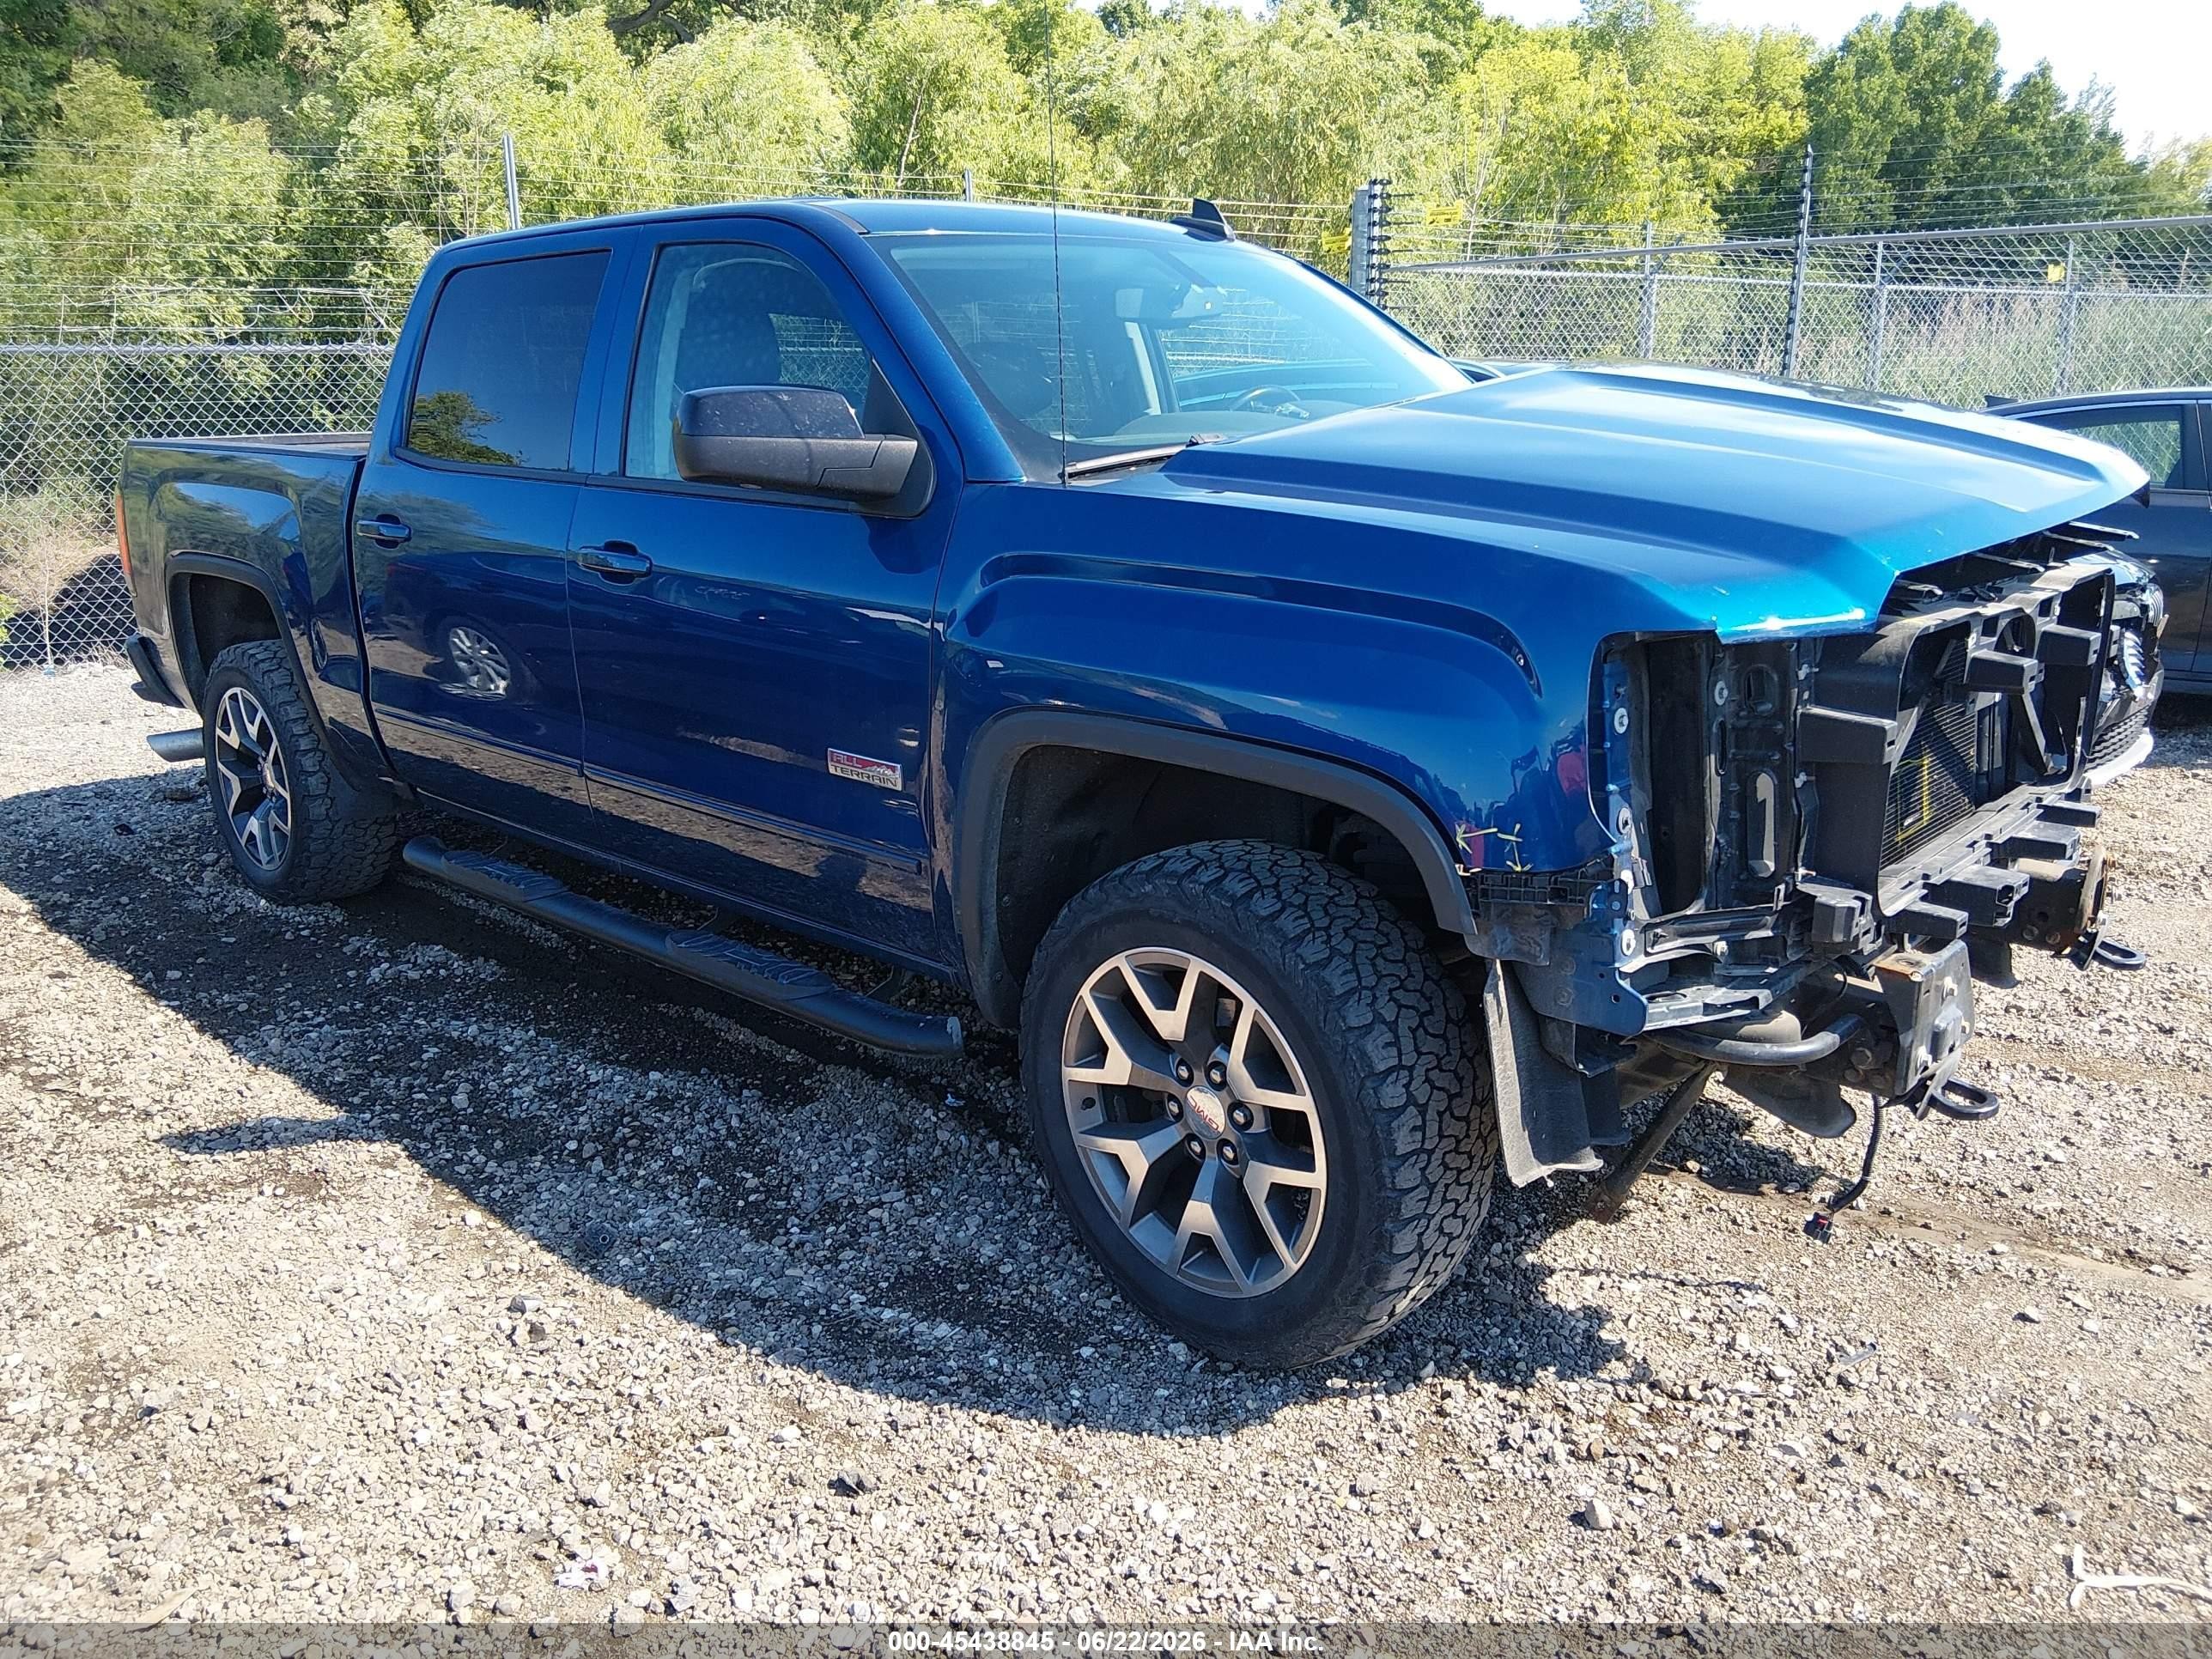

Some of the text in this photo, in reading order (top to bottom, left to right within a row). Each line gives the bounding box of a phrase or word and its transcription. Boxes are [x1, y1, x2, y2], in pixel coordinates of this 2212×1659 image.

[833, 753, 862, 768] ALL
[831, 764, 897, 787] TERRAIN
[1188, 1095, 1219, 1131] GMC
